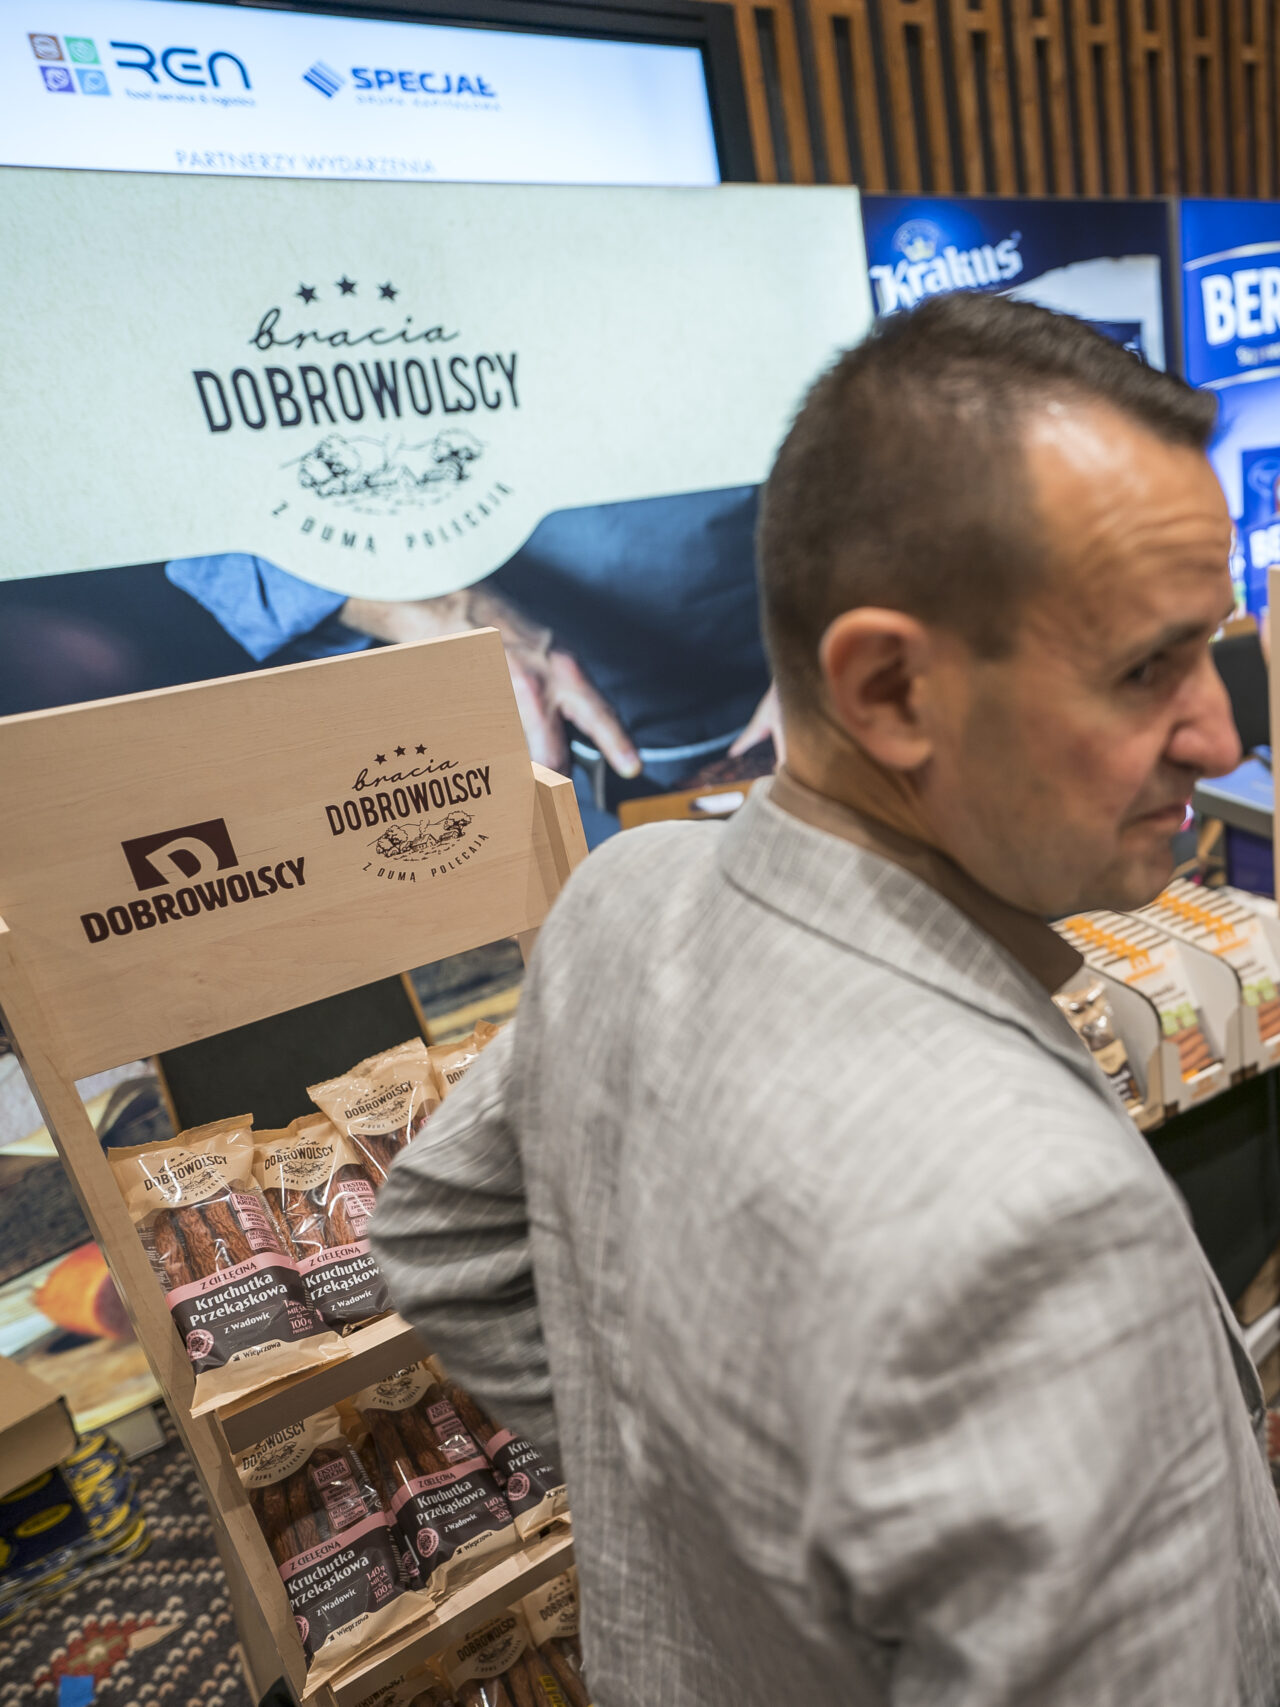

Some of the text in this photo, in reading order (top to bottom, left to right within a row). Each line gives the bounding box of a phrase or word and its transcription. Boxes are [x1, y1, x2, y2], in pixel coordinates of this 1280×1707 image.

[352, 68, 496, 97] SPECJAŁ
[175, 149, 297, 172] PARTNERZY
[869, 239, 1023, 317] Krakus
[248, 307, 460, 350] bracia
[192, 352, 520, 433] DOBROWOLSCY
[352, 759, 459, 791] bracia
[325, 766, 492, 836] DOBROWOLSCY
[362, 862, 372, 871] Z
[377, 868, 416, 883] DUMĄ
[80, 857, 306, 943] DOBROWOLSCY
[344, 1081, 413, 1119] DOBROWOLSCY
[264, 1145, 334, 1170] DOBROWOLSCY
[144, 1155, 227, 1191] DOBROWOLSCY
[317, 1247, 360, 1263] CIELĘCINĄ
[200, 1262, 258, 1290] Z CIELĘCINĄ
[305, 1257, 375, 1288] Kruchutka
[310, 1267, 380, 1300] rzekąskow
[189, 1284, 288, 1327] Przekąskowa
[195, 1273, 273, 1311] Kruchutka
[337, 1290, 373, 1308] Wadowic
[231, 1312, 270, 1331] Wadowic
[290, 1318, 307, 1330] 100
[242, 1341, 281, 1359] Wieprzowa
[416, 1487, 487, 1525] Przekąskowa
[417, 1480, 472, 1508] Kruchutka
[484, 1497, 498, 1509] 140
[448, 1513, 478, 1531] Wadowic
[464, 1532, 493, 1551] Wieprzowa
[289, 1541, 341, 1571] Z CIELĘCINĄ
[288, 1549, 355, 1594] Kruchutka
[366, 1566, 380, 1580] 140
[316, 1588, 357, 1616] z Wadowic
[374, 1585, 388, 1599] 100
[336, 1614, 369, 1636] Wieprzowa
